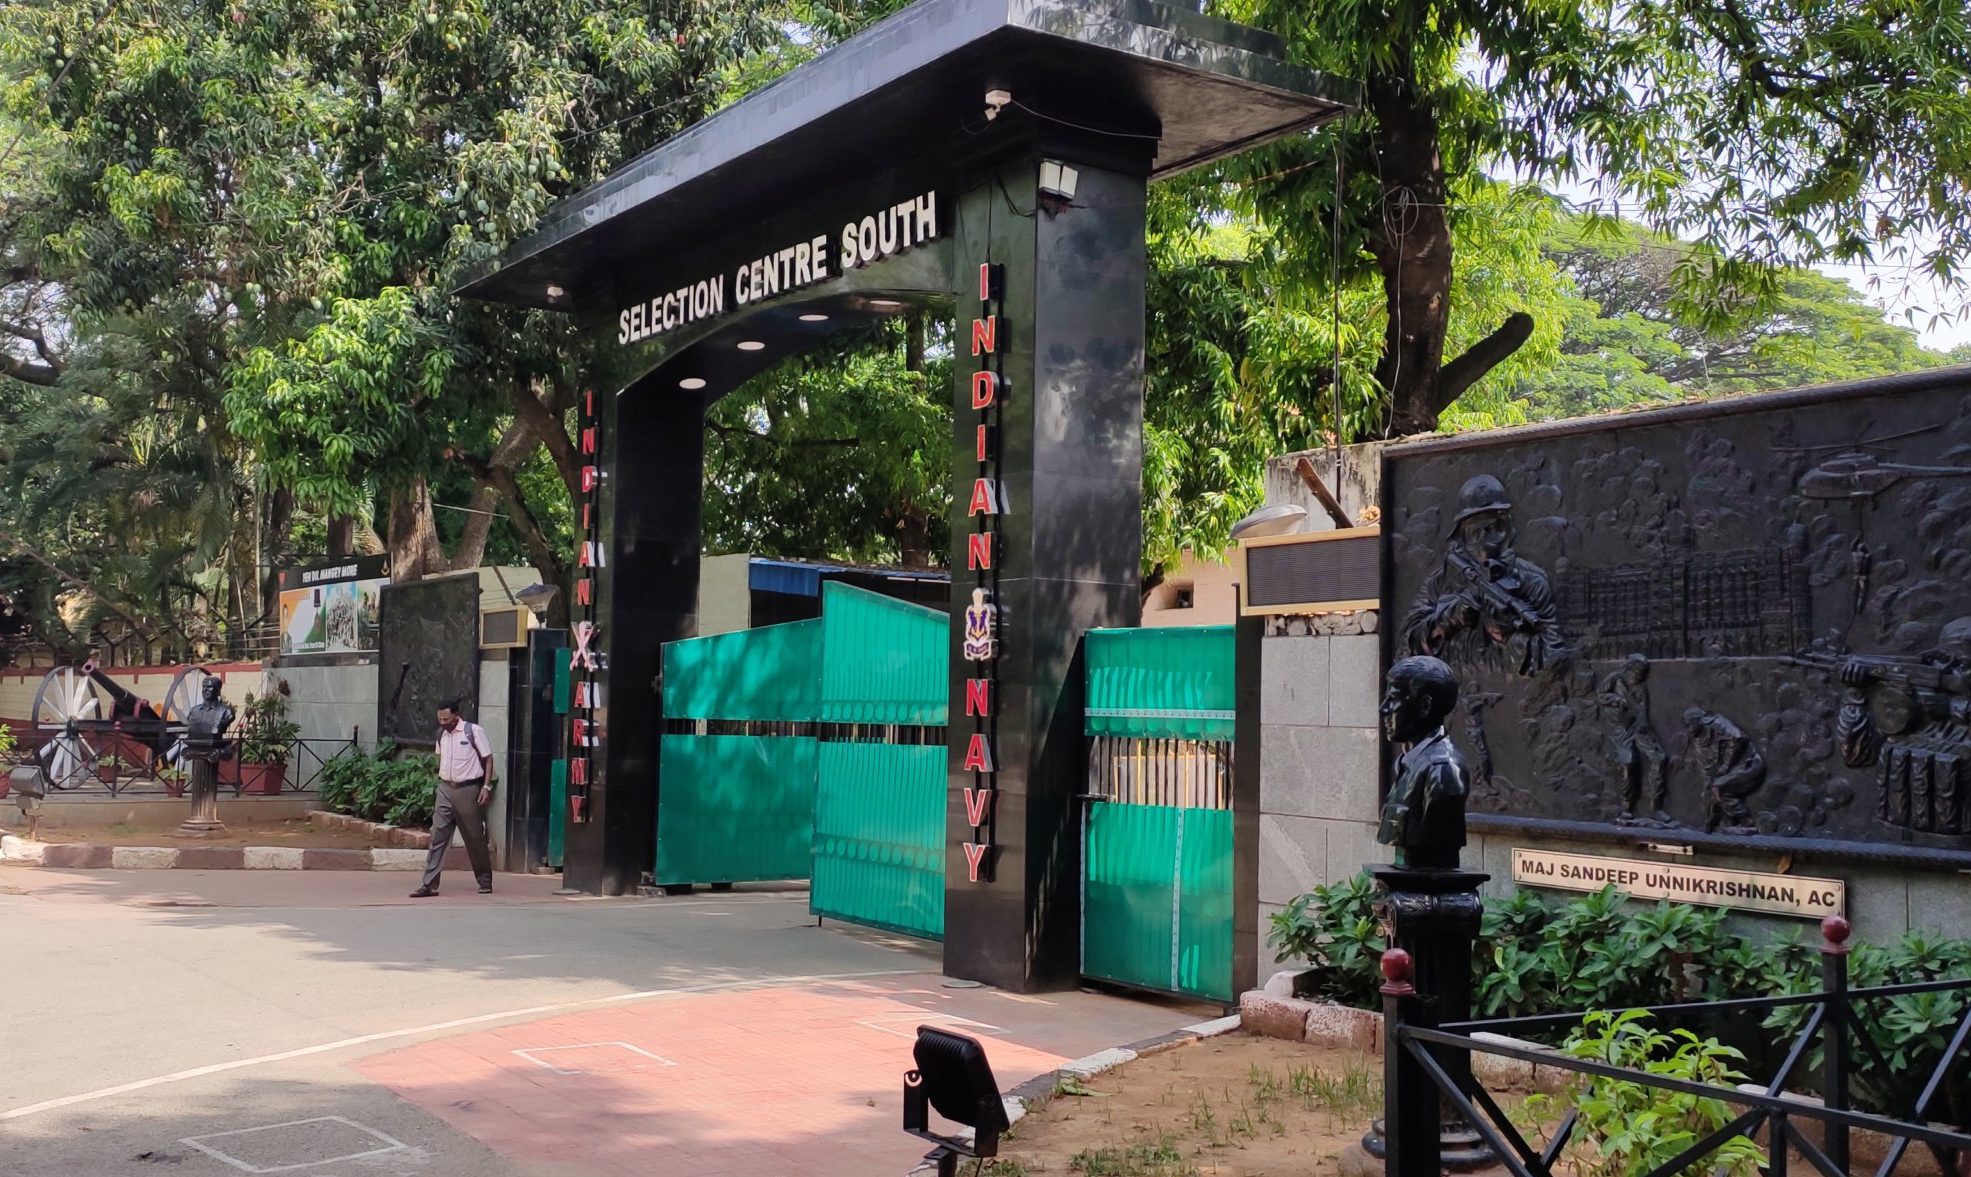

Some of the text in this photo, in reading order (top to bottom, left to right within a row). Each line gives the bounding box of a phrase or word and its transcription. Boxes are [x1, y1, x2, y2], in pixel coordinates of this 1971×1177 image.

[618, 190, 937, 345] SELECTION CENTRE SOUTH
[967, 263, 996, 571] INDIAN
[341, 563, 358, 578] MORE
[571, 389, 595, 824] INDIAN ARMY
[964, 678, 990, 882] NAVY
[1521, 859, 1836, 908] MAJ SANDEEP UNNIKRISHNAN, AC
